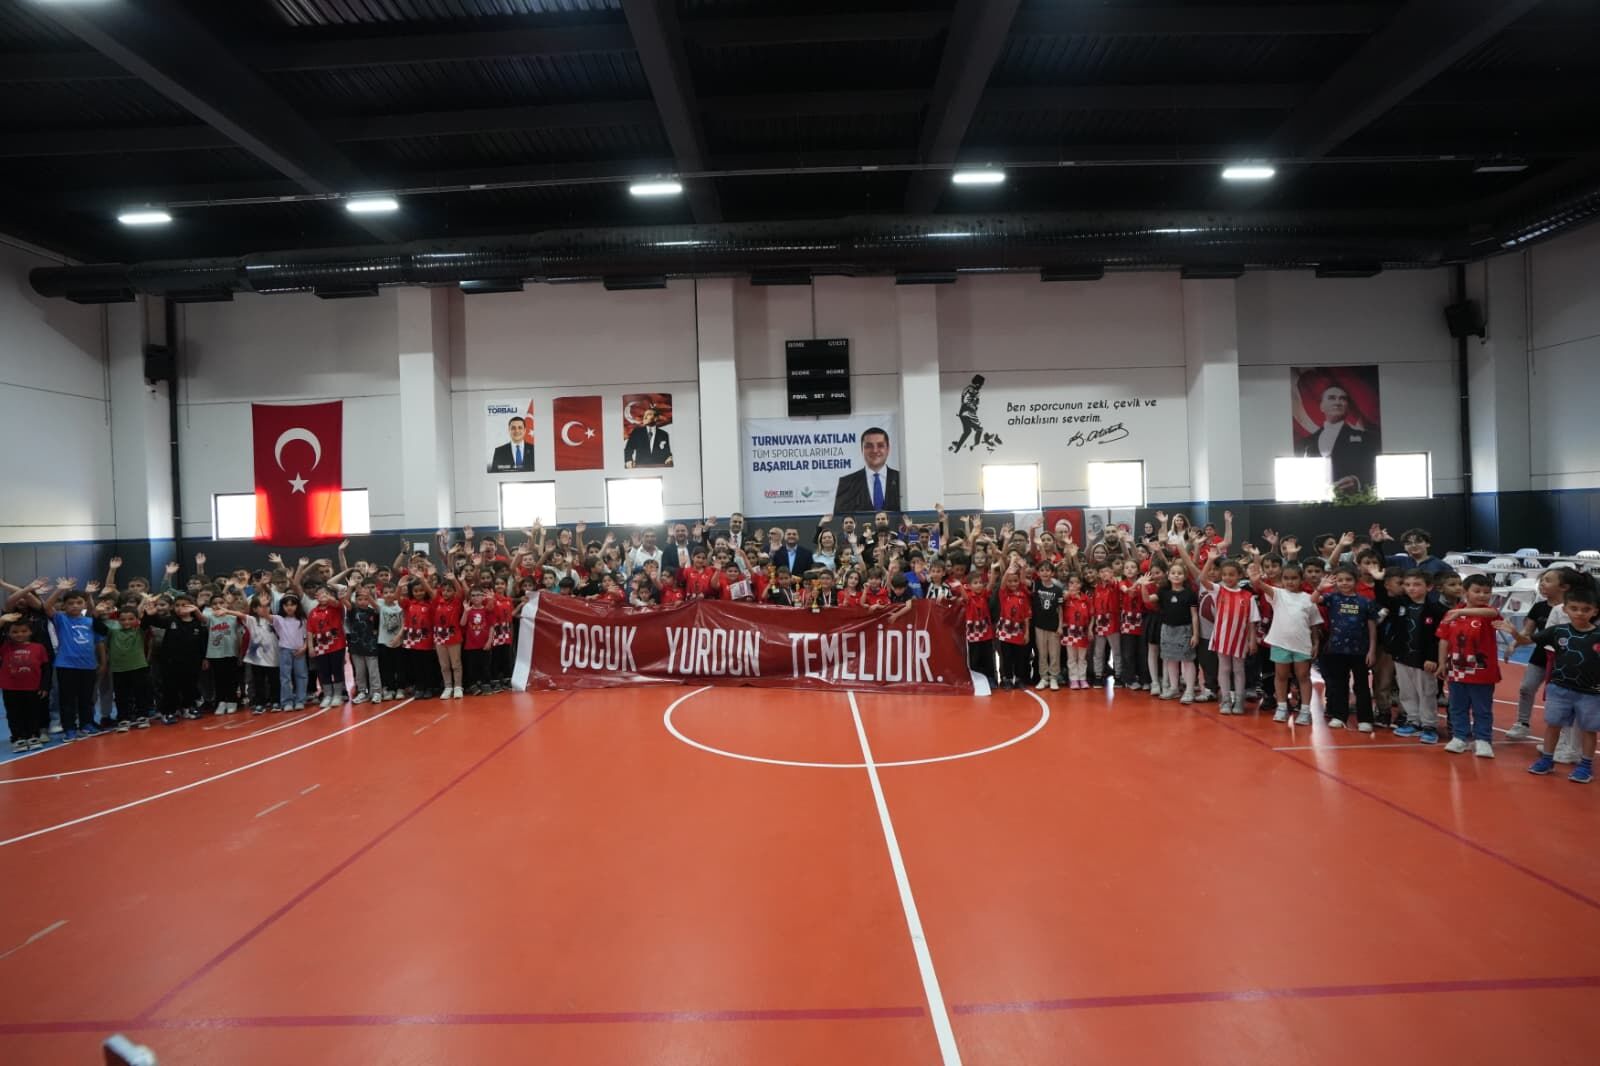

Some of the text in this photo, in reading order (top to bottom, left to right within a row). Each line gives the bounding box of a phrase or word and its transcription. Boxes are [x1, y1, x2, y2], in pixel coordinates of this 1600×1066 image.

[1006, 397, 1157, 412] Ben sporcunun zeki, çevik ve
[1007, 413, 1102, 426] ahlaklısını severim.
[752, 432, 856, 447] TURNUVAYA KATILAN
[752, 447, 844, 459] TÜM SPORCULARIMIZA
[752, 459, 852, 473] BAŞARILAR DİLERİM
[561, 622, 944, 683] ÇOCUK YURDUN TEMELİDİR.
